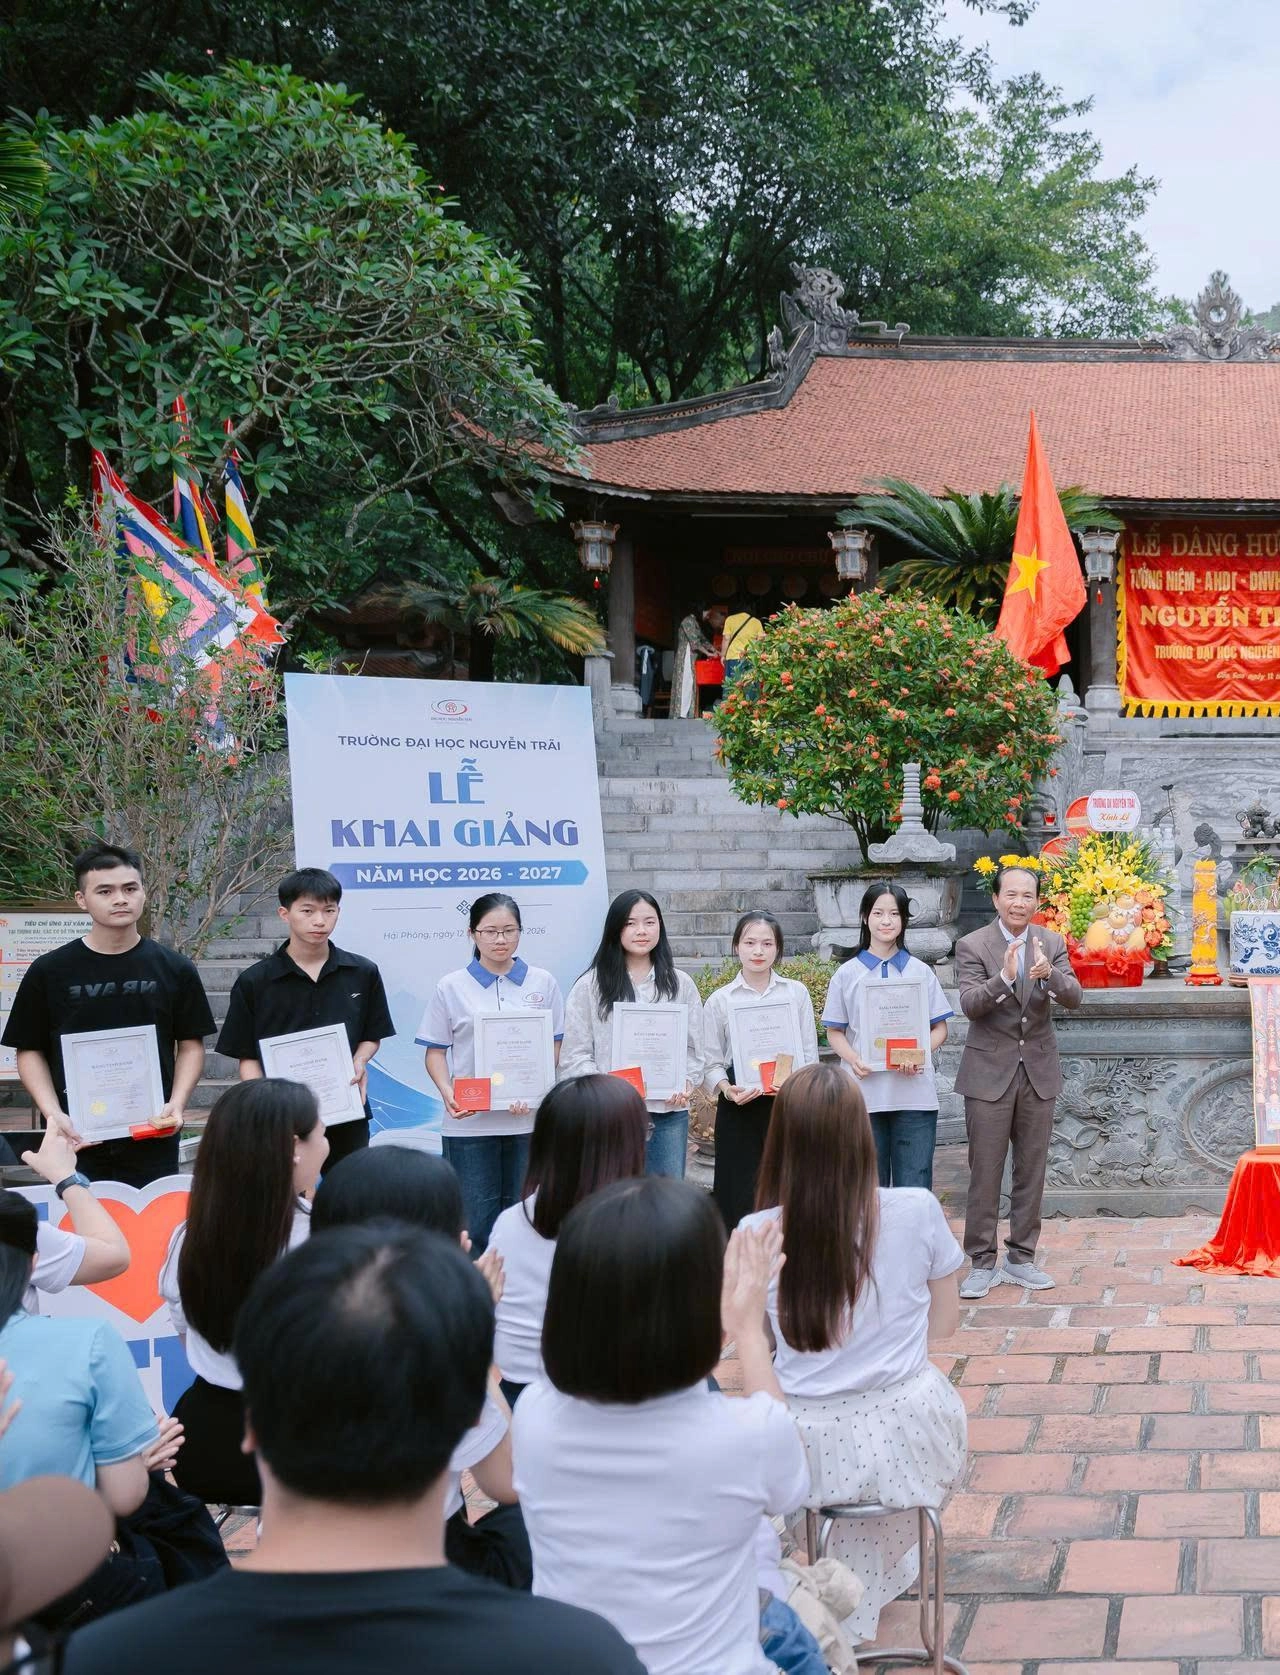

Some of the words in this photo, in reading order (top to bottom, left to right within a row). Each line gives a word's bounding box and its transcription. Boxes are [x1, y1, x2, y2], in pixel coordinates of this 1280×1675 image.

[1131, 523, 1161, 557] LỄ
[1171, 525, 1239, 557] DÂNG
[1166, 567, 1195, 595] NIỆM
[1140, 596, 1249, 627] NGUYỄN
[1155, 642, 1193, 660] TRƯỜNG
[1217, 645, 1237, 662] HỌC
[1240, 642, 1280, 660] NGUYỄN
[338, 734, 401, 748] TRƯỜNG
[405, 737, 430, 750] ĐẠI
[435, 738, 465, 751] HỌC
[469, 734, 527, 751] NGUYỄN
[530, 736, 561, 751] TRÃI
[428, 757, 485, 804] LỄ
[331, 819, 441, 847] KHAI
[454, 811, 579, 847] GIẢNG
[356, 866, 403, 882] NĂM
[410, 868, 452, 885] HỌC
[457, 867, 502, 881] 2026
[520, 867, 562, 880] 2027
[433, 930, 455, 940] ngày
[526, 927, 546, 935] 2026
